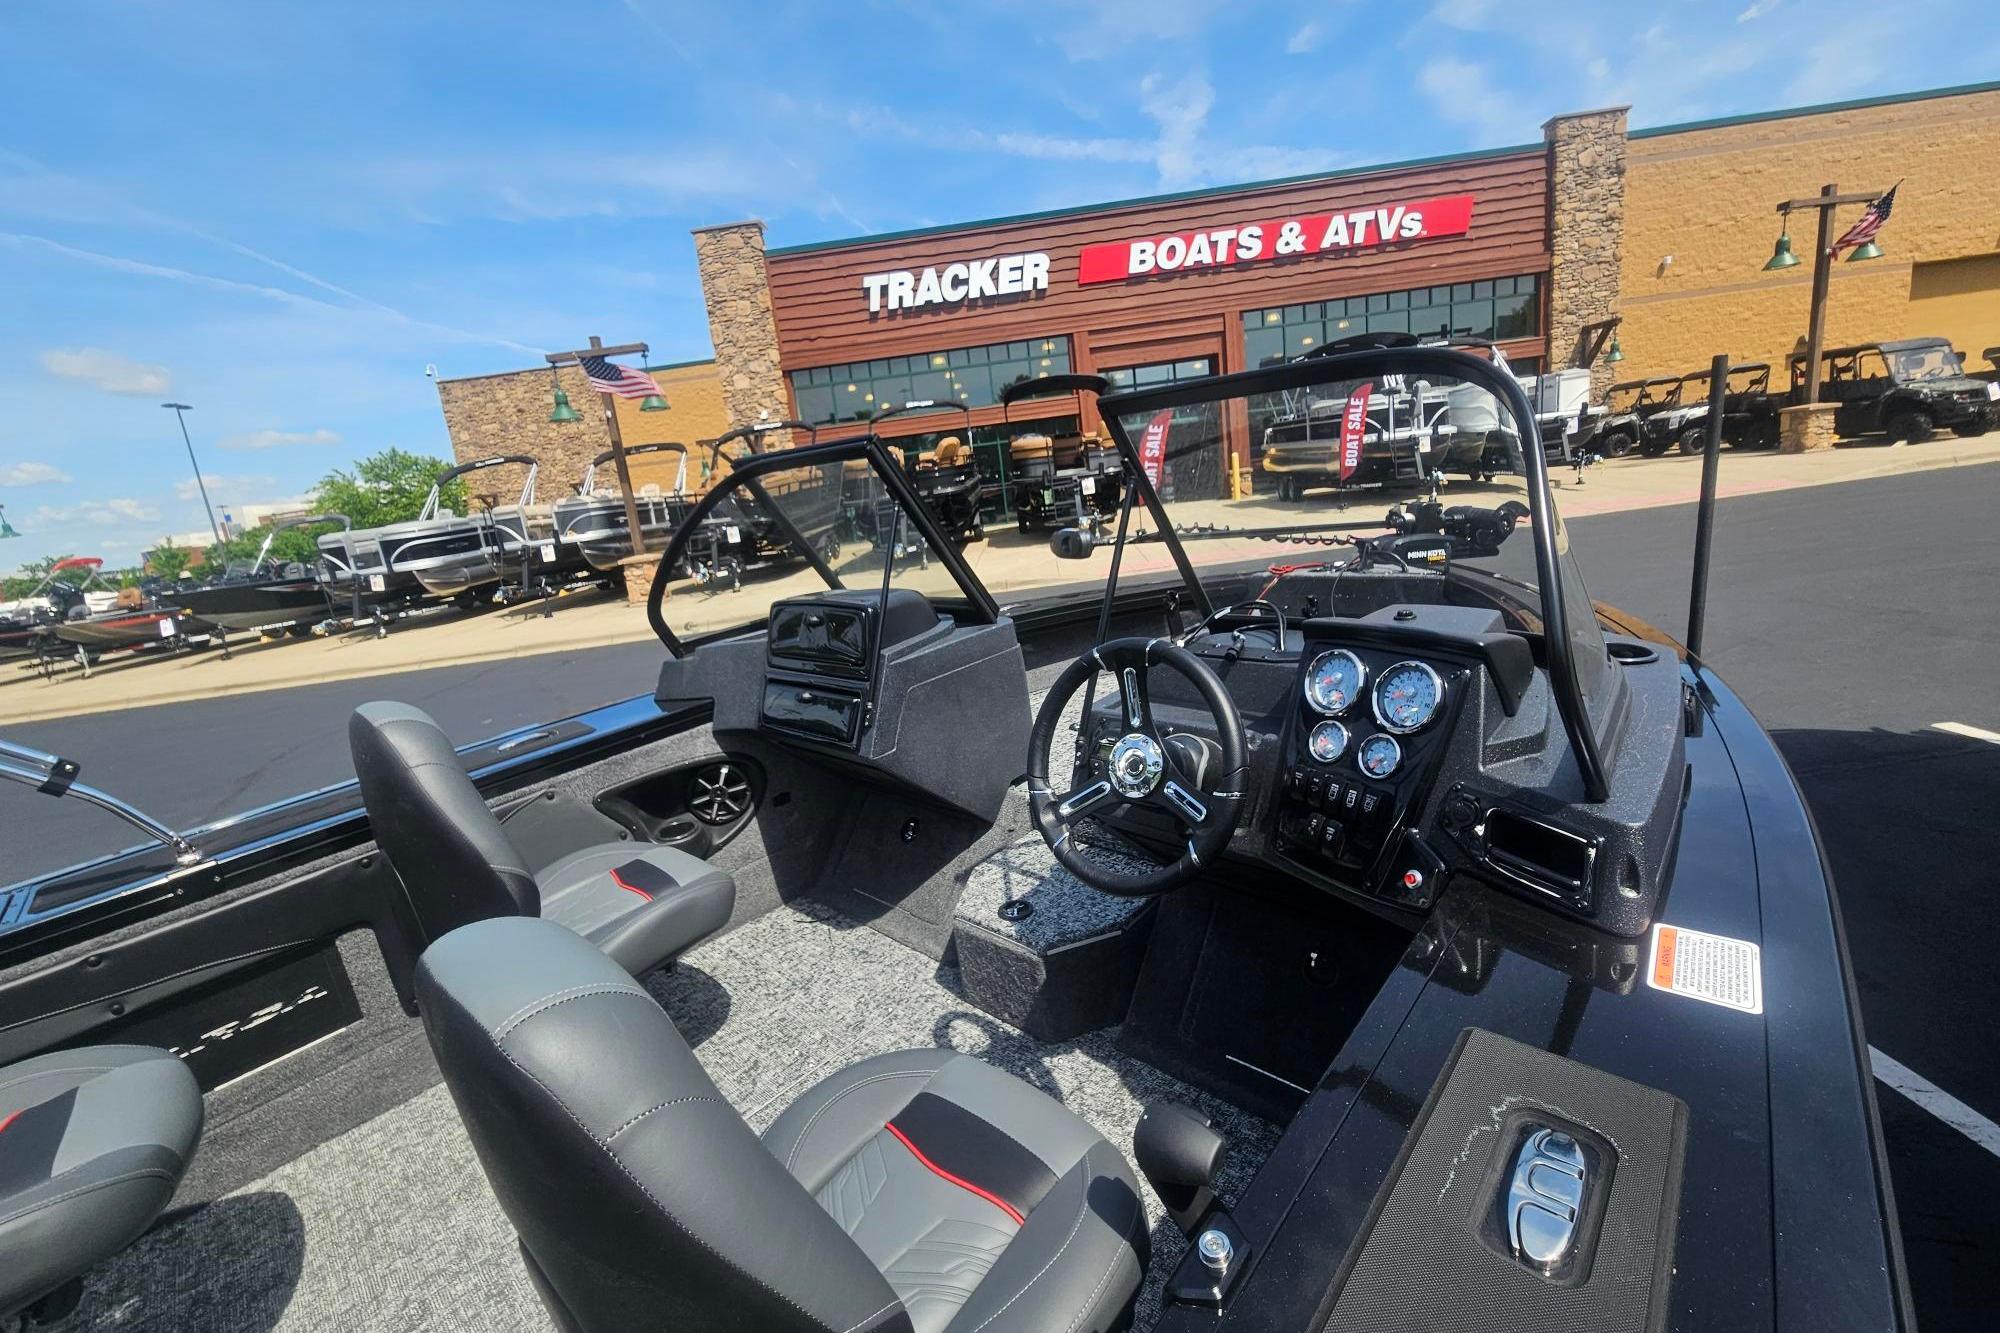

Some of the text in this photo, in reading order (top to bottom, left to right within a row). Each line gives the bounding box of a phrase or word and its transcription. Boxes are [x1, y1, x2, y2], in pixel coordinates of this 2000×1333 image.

[1128, 206, 1423, 274] BOATS & ATVs
[863, 252, 1051, 312] TRACKER
[1347, 397, 1364, 430] SALE
[1144, 424, 1163, 492] OAT SALE
[1345, 433, 1359, 466] BOAT
[1407, 550, 1427, 559] MINN
[1427, 548, 1446, 561] KOTA
